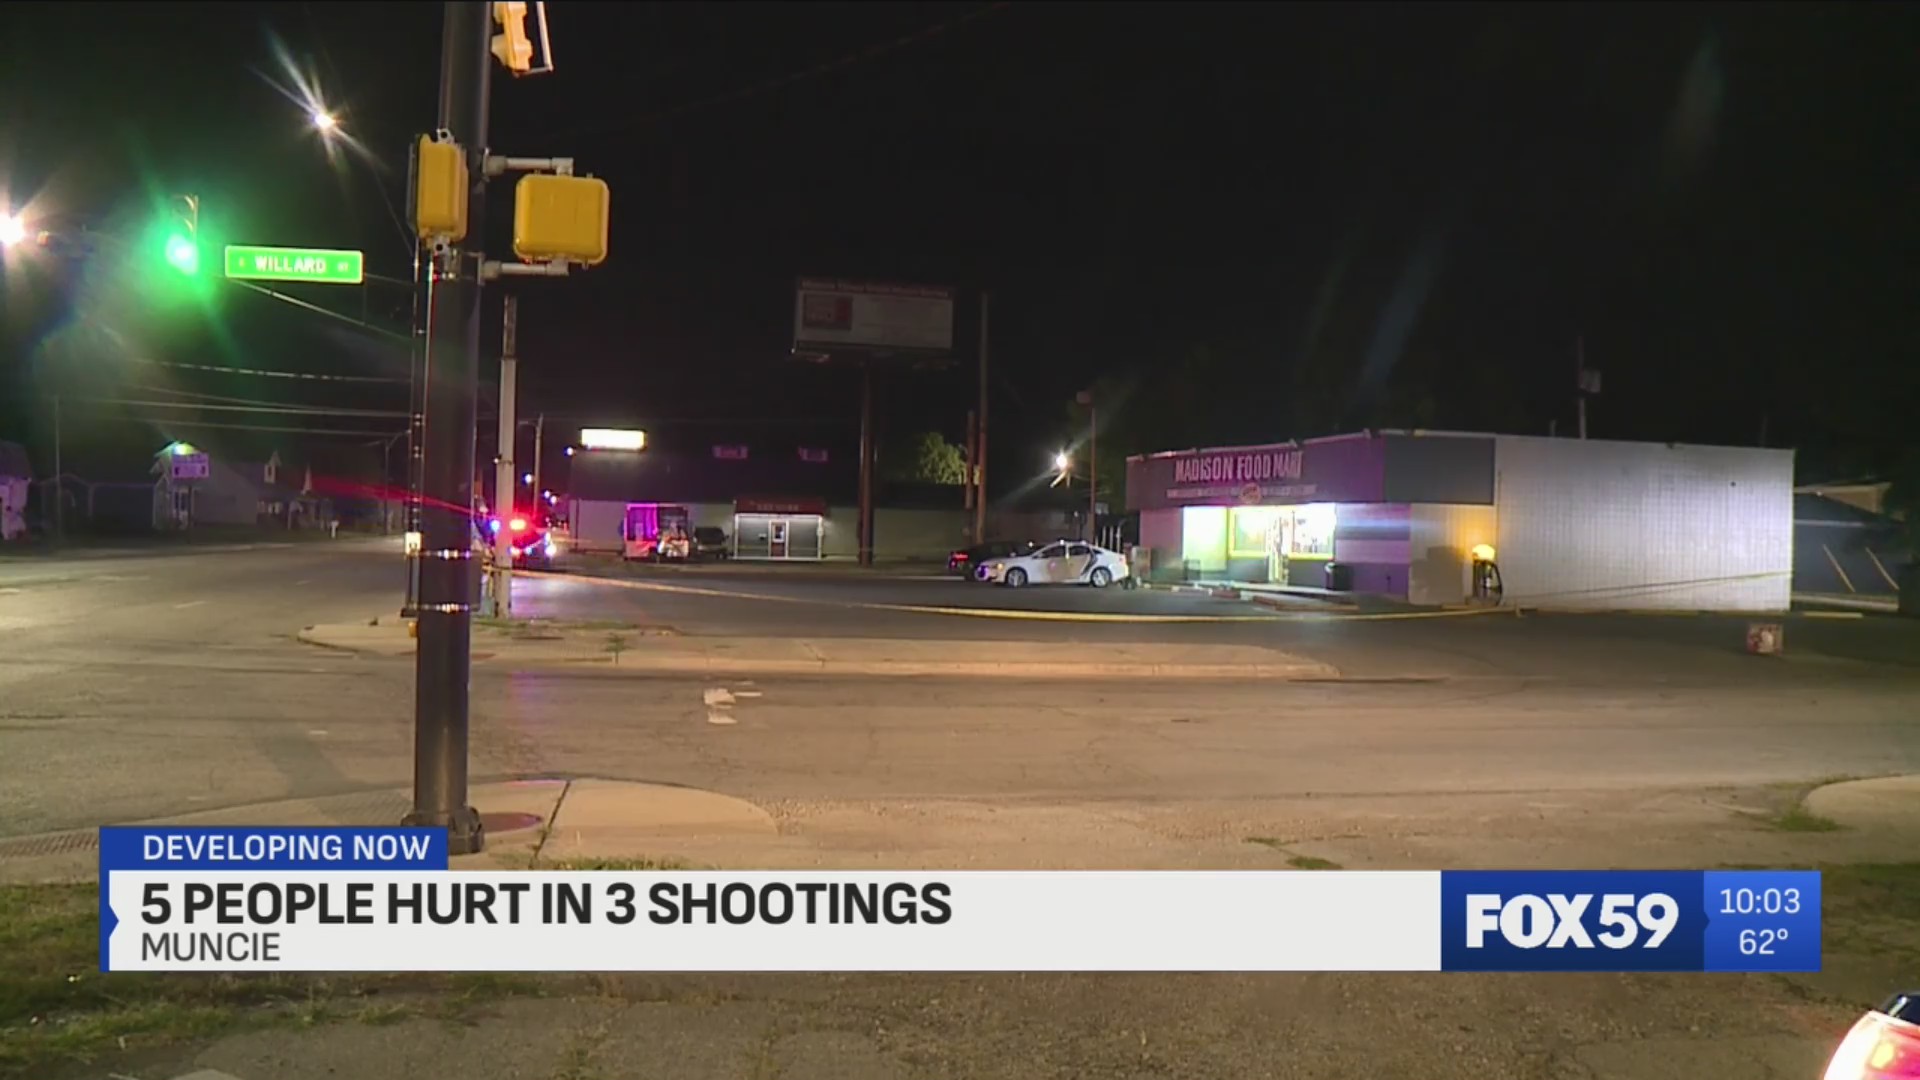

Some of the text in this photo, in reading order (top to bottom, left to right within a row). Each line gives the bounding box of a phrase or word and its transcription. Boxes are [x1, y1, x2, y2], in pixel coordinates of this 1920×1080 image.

[255, 255, 327, 274] WILLARD
[1175, 451, 1303, 482] MADISON FOOD MART
